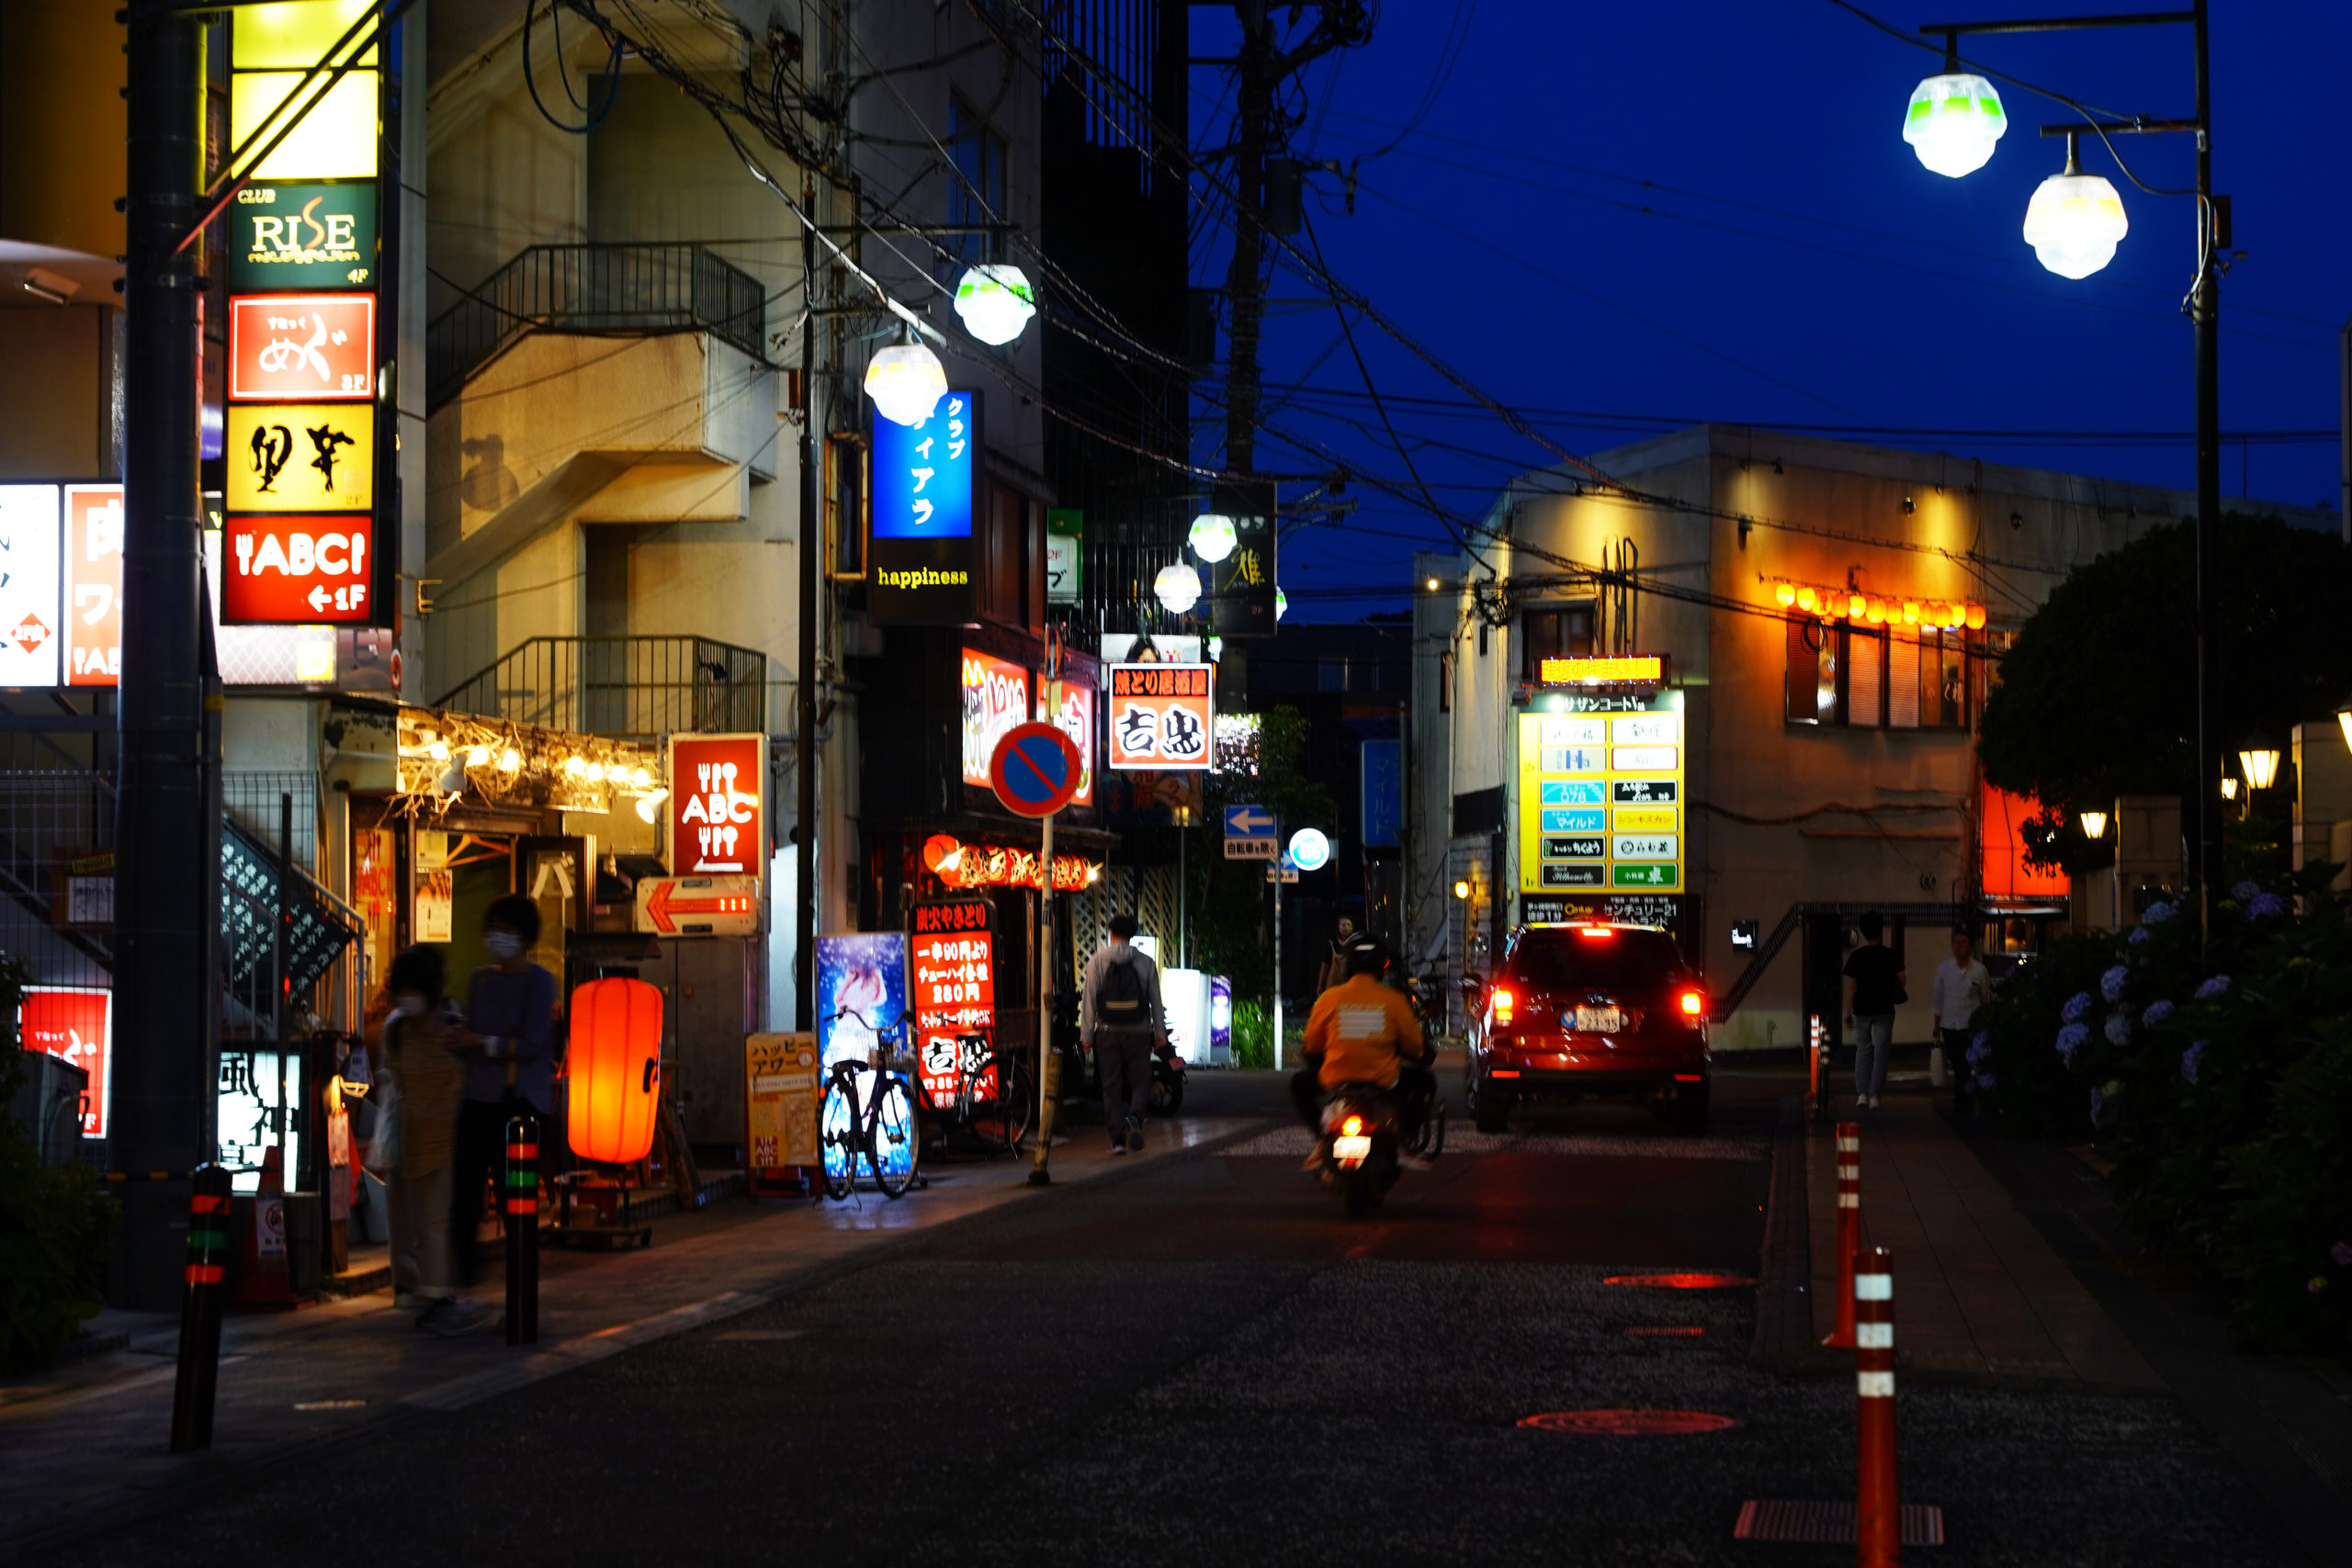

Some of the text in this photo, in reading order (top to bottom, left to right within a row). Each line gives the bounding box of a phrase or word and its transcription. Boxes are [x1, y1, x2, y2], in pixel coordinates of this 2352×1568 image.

[237, 188, 277, 204] CLUB
[252, 196, 356, 252] RISE
[877, 566, 968, 589] happiness
[682, 793, 752, 825] ABC
[1227, 841, 1276, 855] 自転車を除く
[1603, 903, 1677, 917] センチュリー21
[752, 1040, 813, 1056] ハッピー
[752, 1057, 797, 1074] アワー
